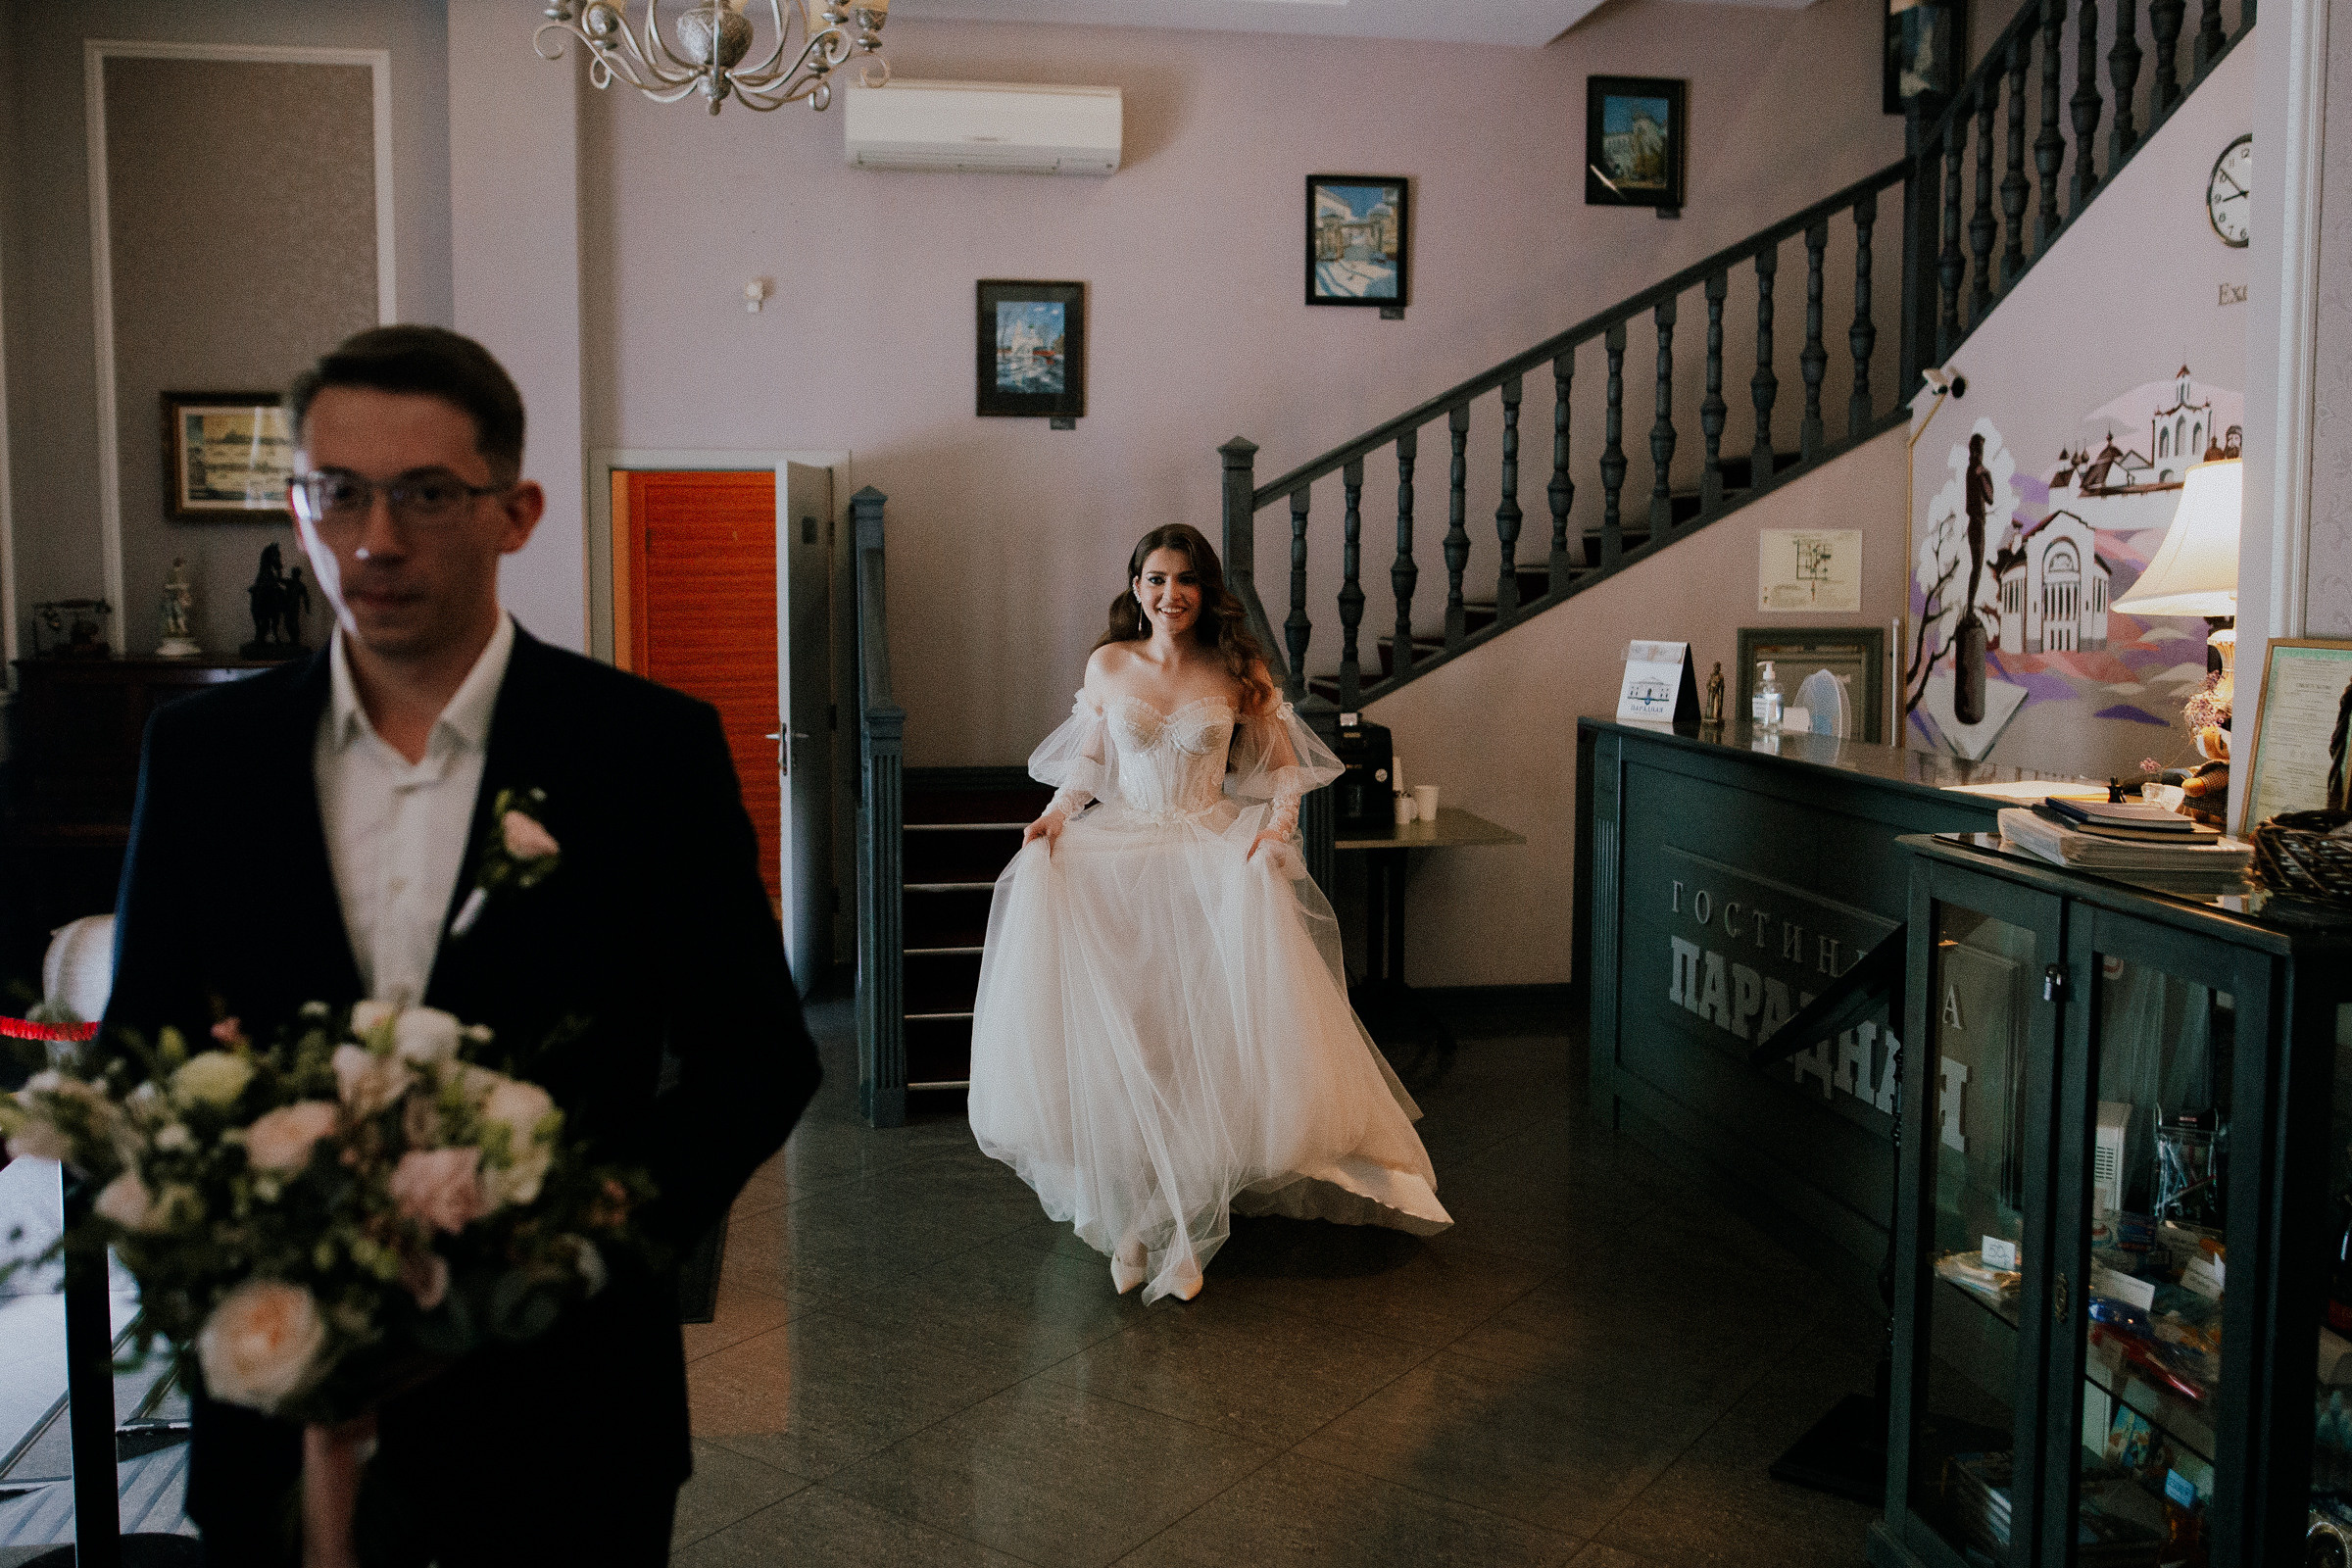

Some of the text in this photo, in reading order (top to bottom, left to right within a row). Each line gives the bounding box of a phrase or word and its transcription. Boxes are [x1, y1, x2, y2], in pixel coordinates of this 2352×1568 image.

[2240, 147, 2251, 159] 12
[2228, 157, 2235, 168] 11
[2214, 193, 2222, 204] 9
[2219, 212, 2227, 222] 8
[2228, 224, 2234, 235] 7
[1672, 880, 1964, 1030] ГОСТИНА
